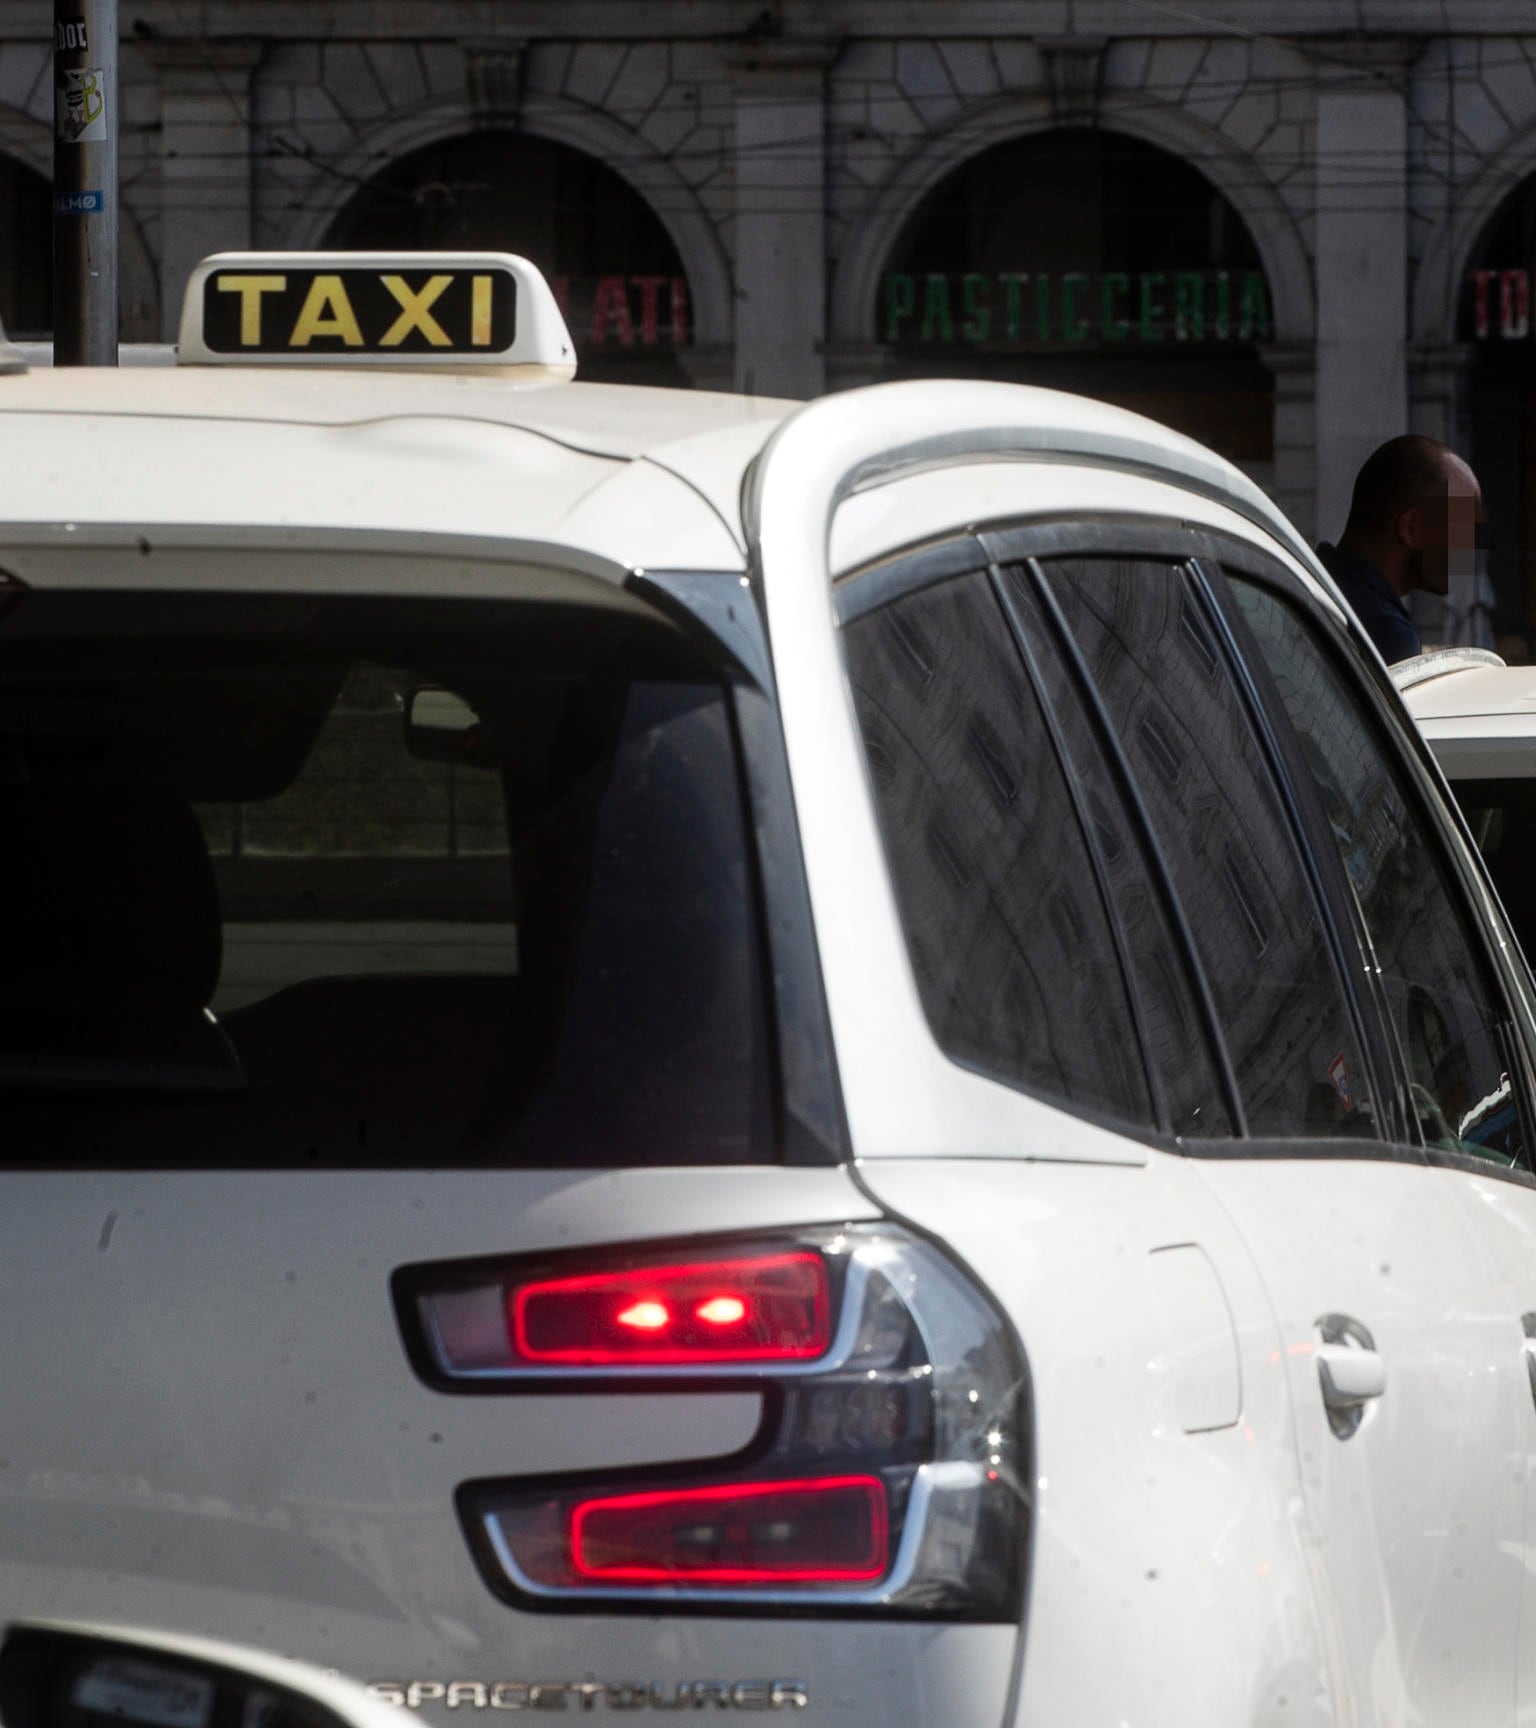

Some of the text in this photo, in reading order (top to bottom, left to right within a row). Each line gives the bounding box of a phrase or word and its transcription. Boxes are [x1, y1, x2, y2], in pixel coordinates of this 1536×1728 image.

[217, 275, 493, 346] TAXI
[886, 272, 1269, 342] PASTICCERIA
[366, 1680, 808, 1711] SPACETOURER
